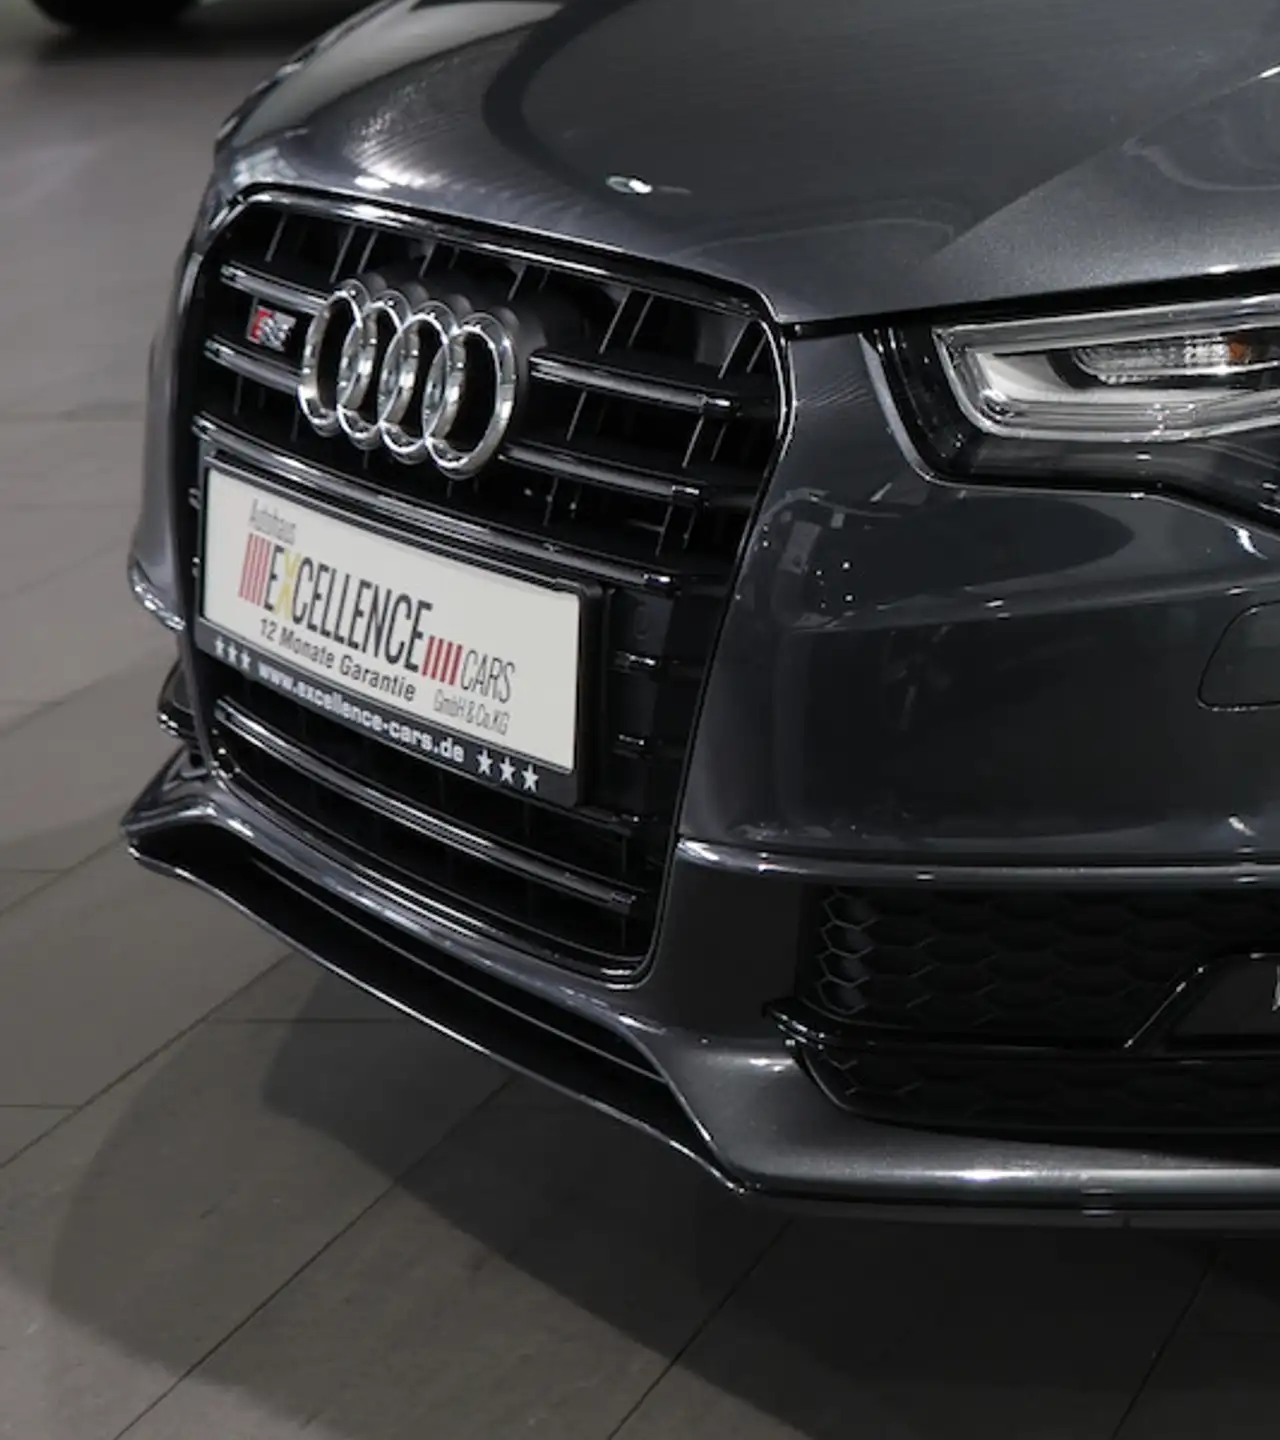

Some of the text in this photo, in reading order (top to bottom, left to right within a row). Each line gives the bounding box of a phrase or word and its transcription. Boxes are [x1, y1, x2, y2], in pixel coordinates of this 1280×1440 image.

[261, 618, 416, 702] 12 Monate Garantie
[264, 544, 516, 704] EXCELLENCE CARS
[258, 662, 465, 763] www.excellence-cars.de
